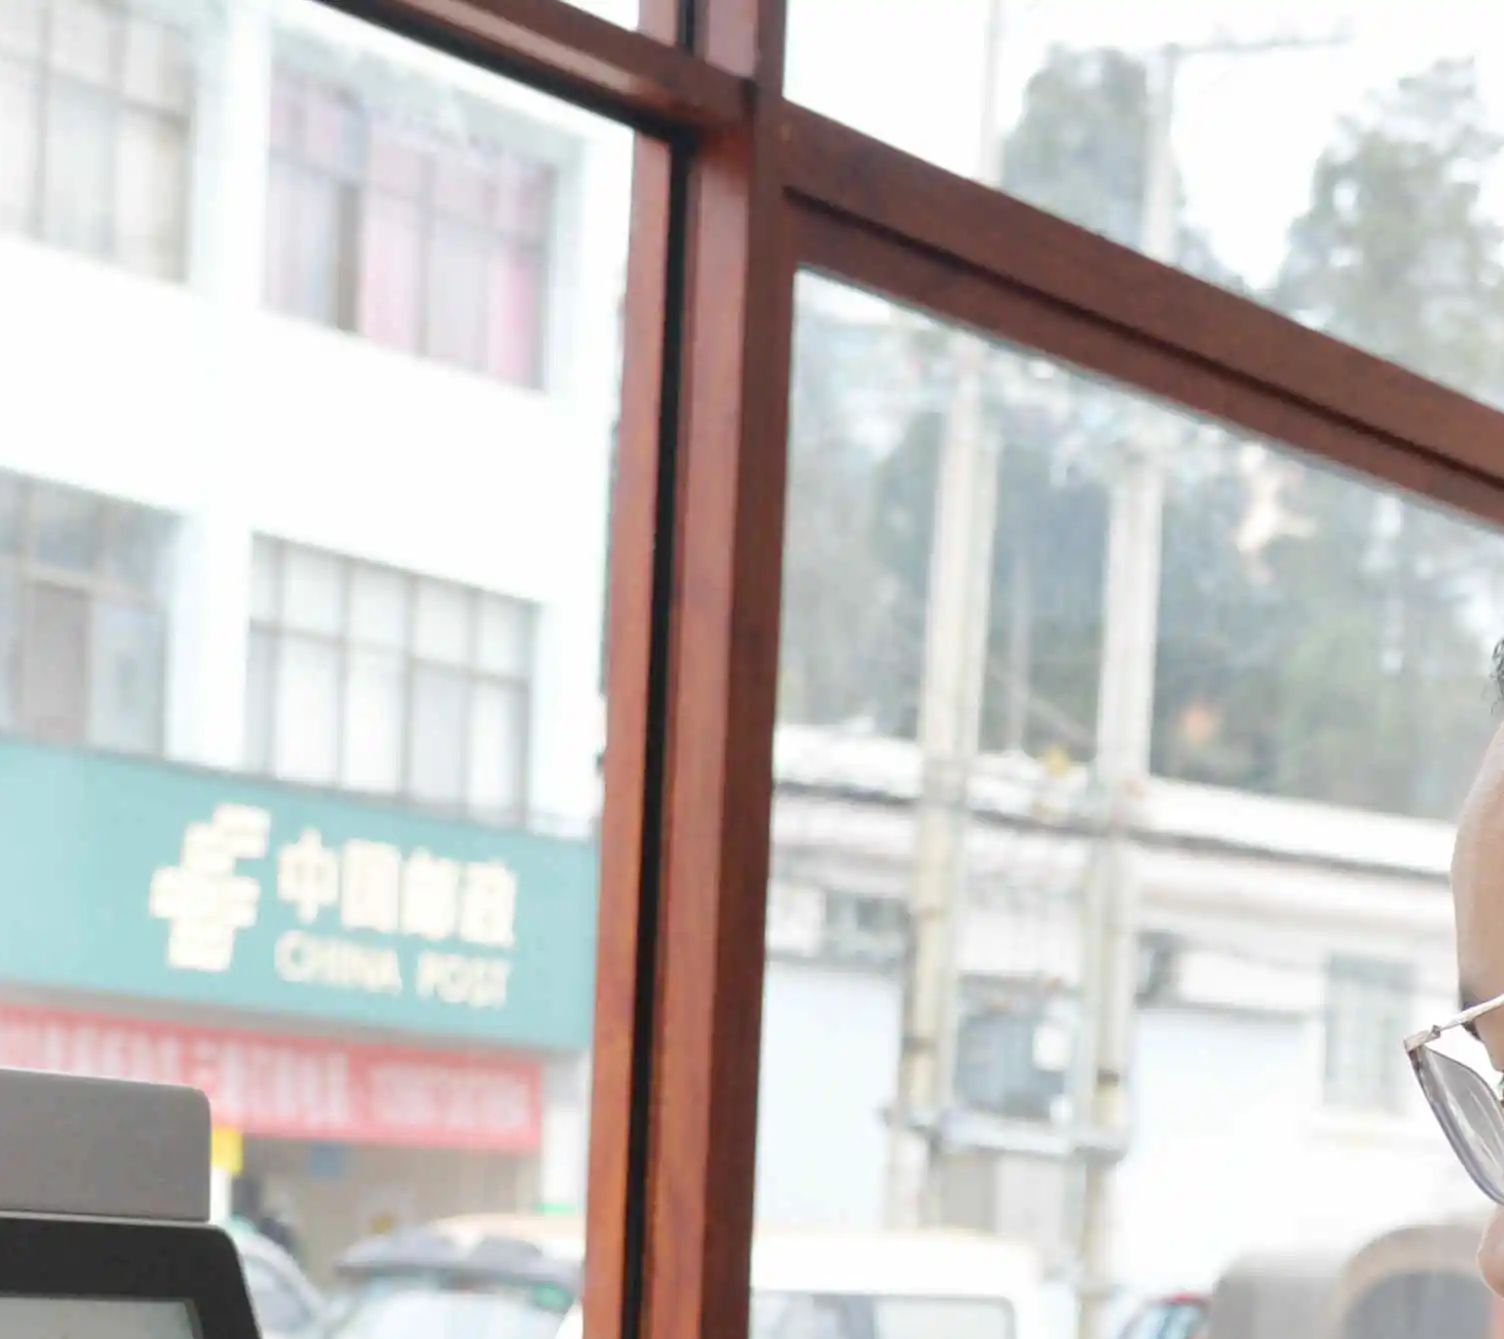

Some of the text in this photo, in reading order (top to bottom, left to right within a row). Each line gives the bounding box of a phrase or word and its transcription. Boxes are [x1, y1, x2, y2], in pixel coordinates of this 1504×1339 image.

[277, 826, 517, 948] 中国邮政
[274, 930, 510, 1008] CHINA POST
